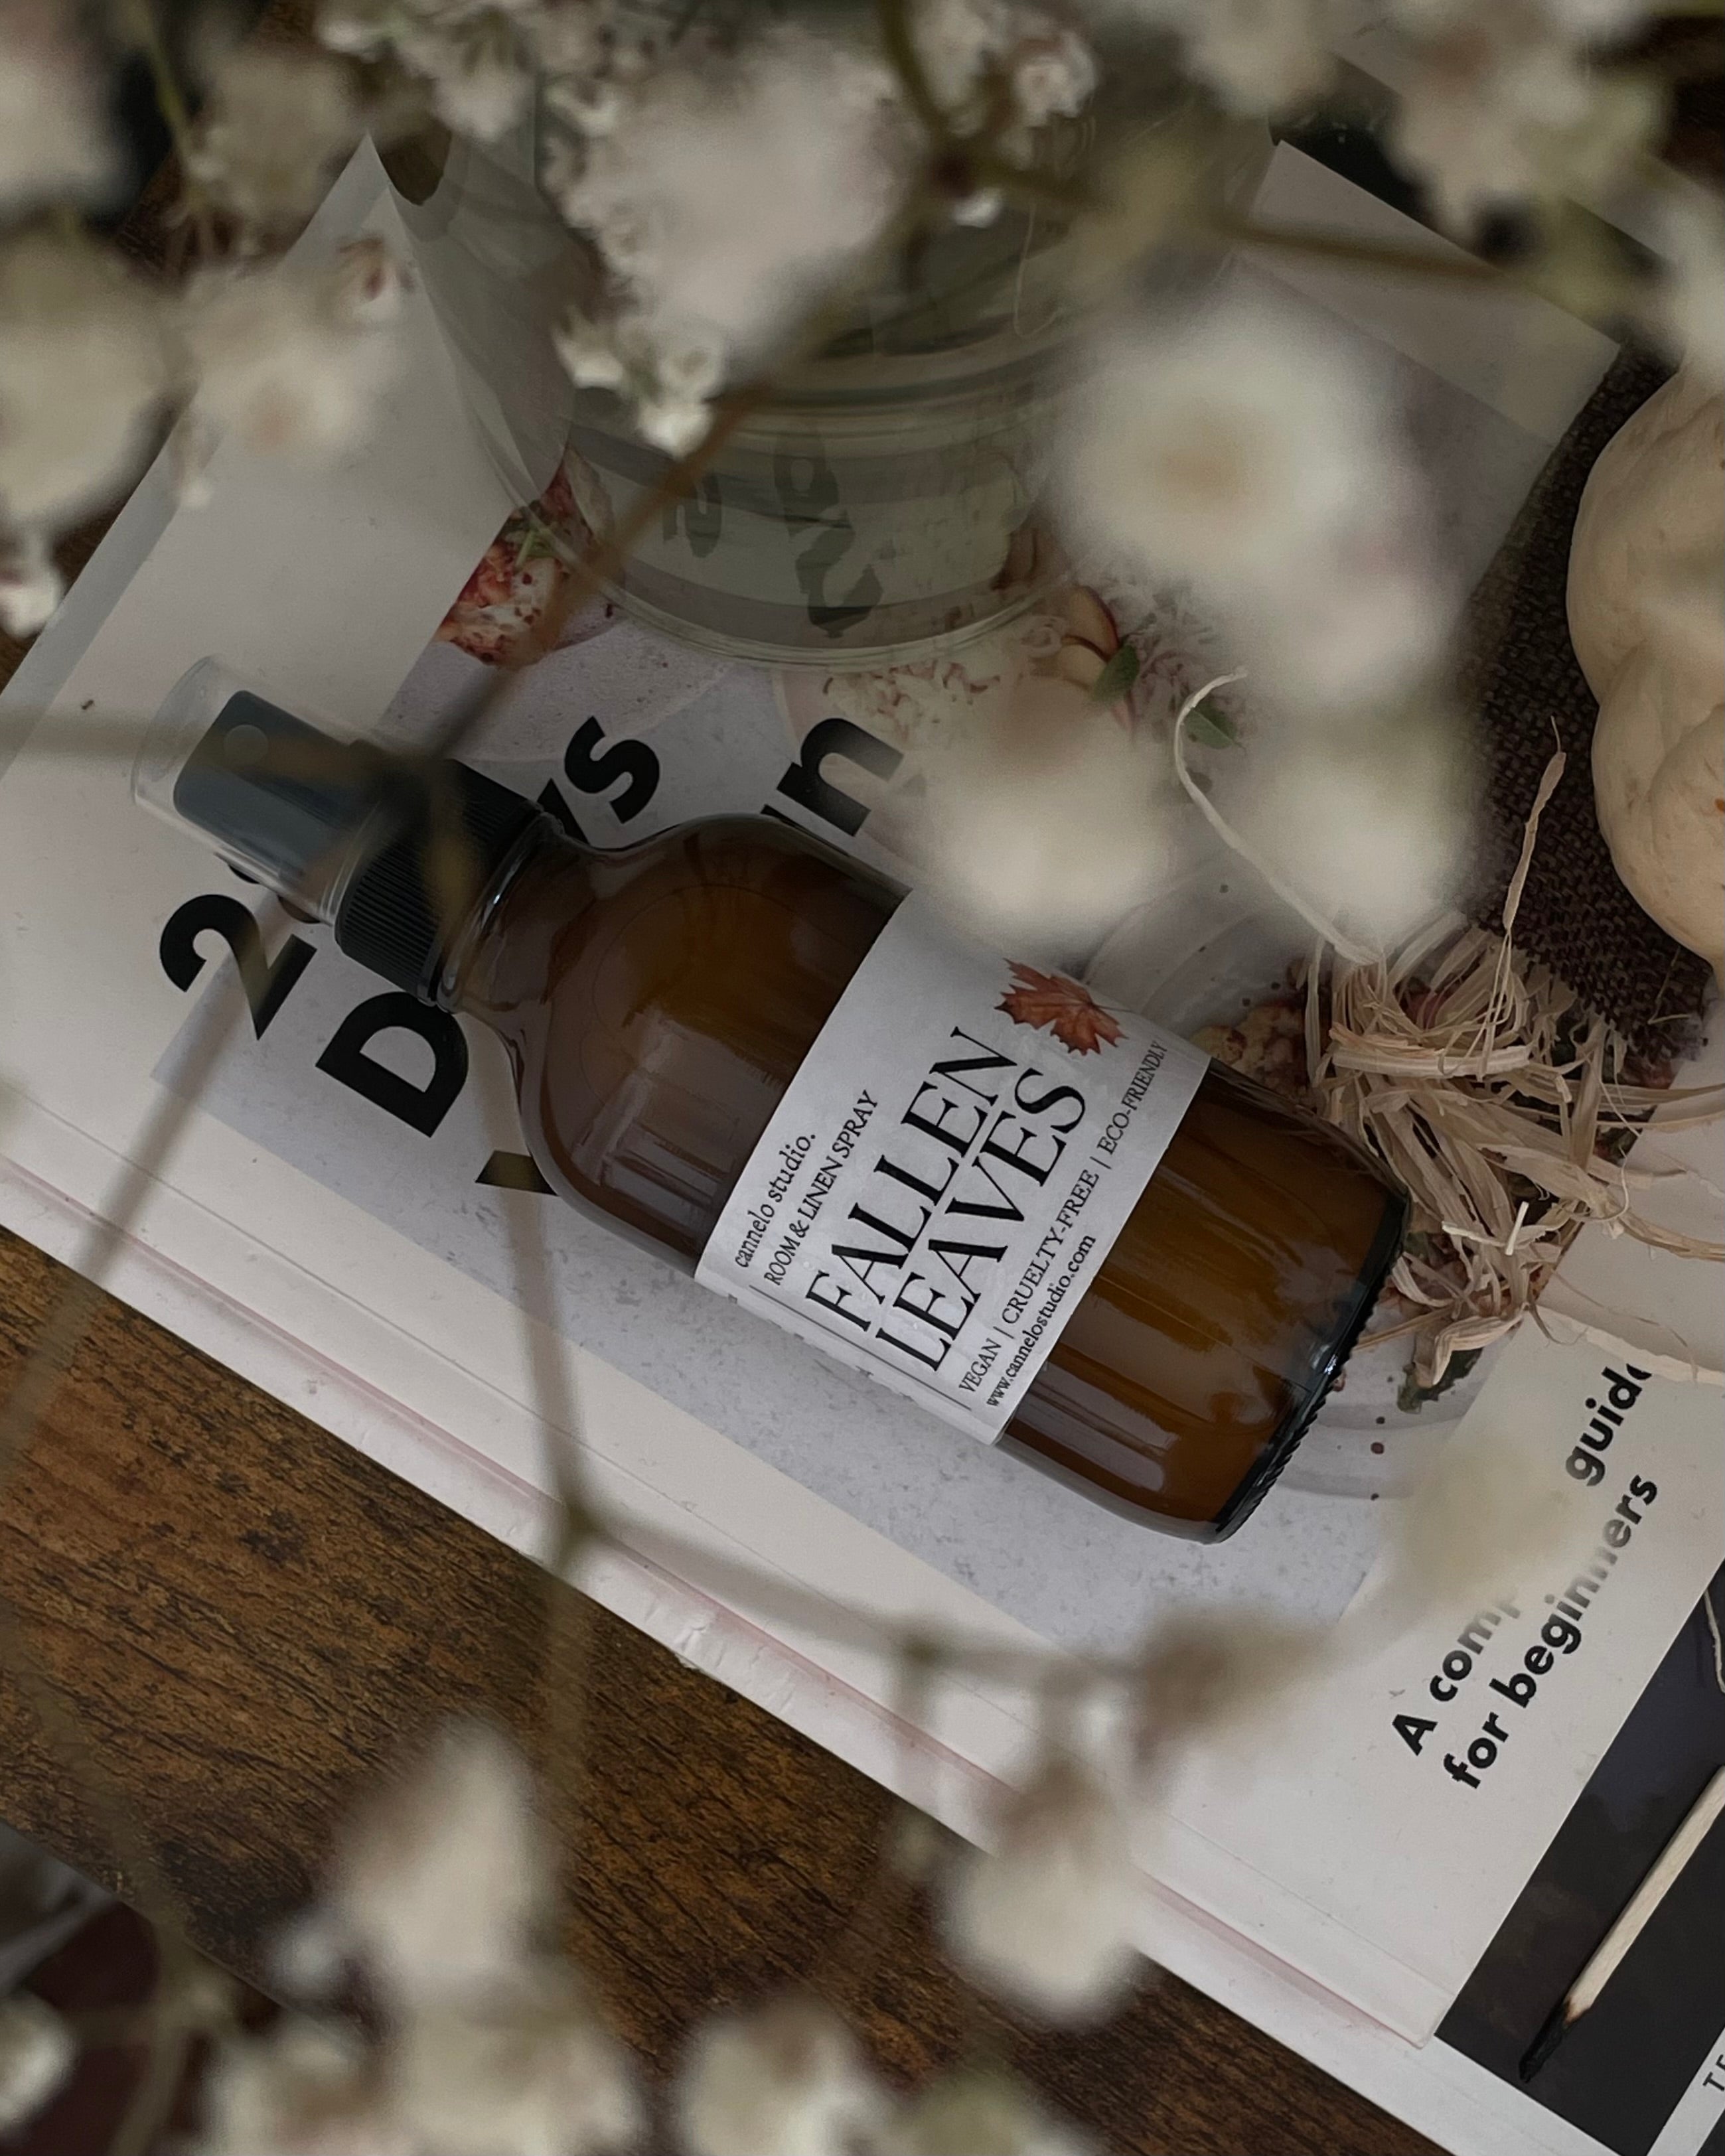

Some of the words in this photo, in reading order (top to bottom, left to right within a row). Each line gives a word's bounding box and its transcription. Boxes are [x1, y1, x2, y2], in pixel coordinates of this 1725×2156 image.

[316, 715, 661, 1139] Ds
[735, 1204, 775, 1267] cannelo
[768, 1134, 815, 1202] studio.
[797, 1156, 844, 1220] LINEN
[805, 1026, 1017, 1332] FALLEN
[832, 1090, 877, 1159] SPRAY
[764, 1235, 800, 1285] ROOM
[789, 1220, 810, 1238] &
[875, 1068, 1086, 1371] LEAVES
[958, 1338, 1002, 1392] VEGAN
[1002, 1169, 1099, 1324] CRUELTY-FREE
[1096, 1041, 1167, 1155] ECO-FRIENDLY
[986, 1235, 1096, 1407] www.cannelostudio.com
[1443, 1711, 1509, 1788] for
[1489, 1474, 1657, 1707] beginners
[1392, 1713, 1438, 1756] A
